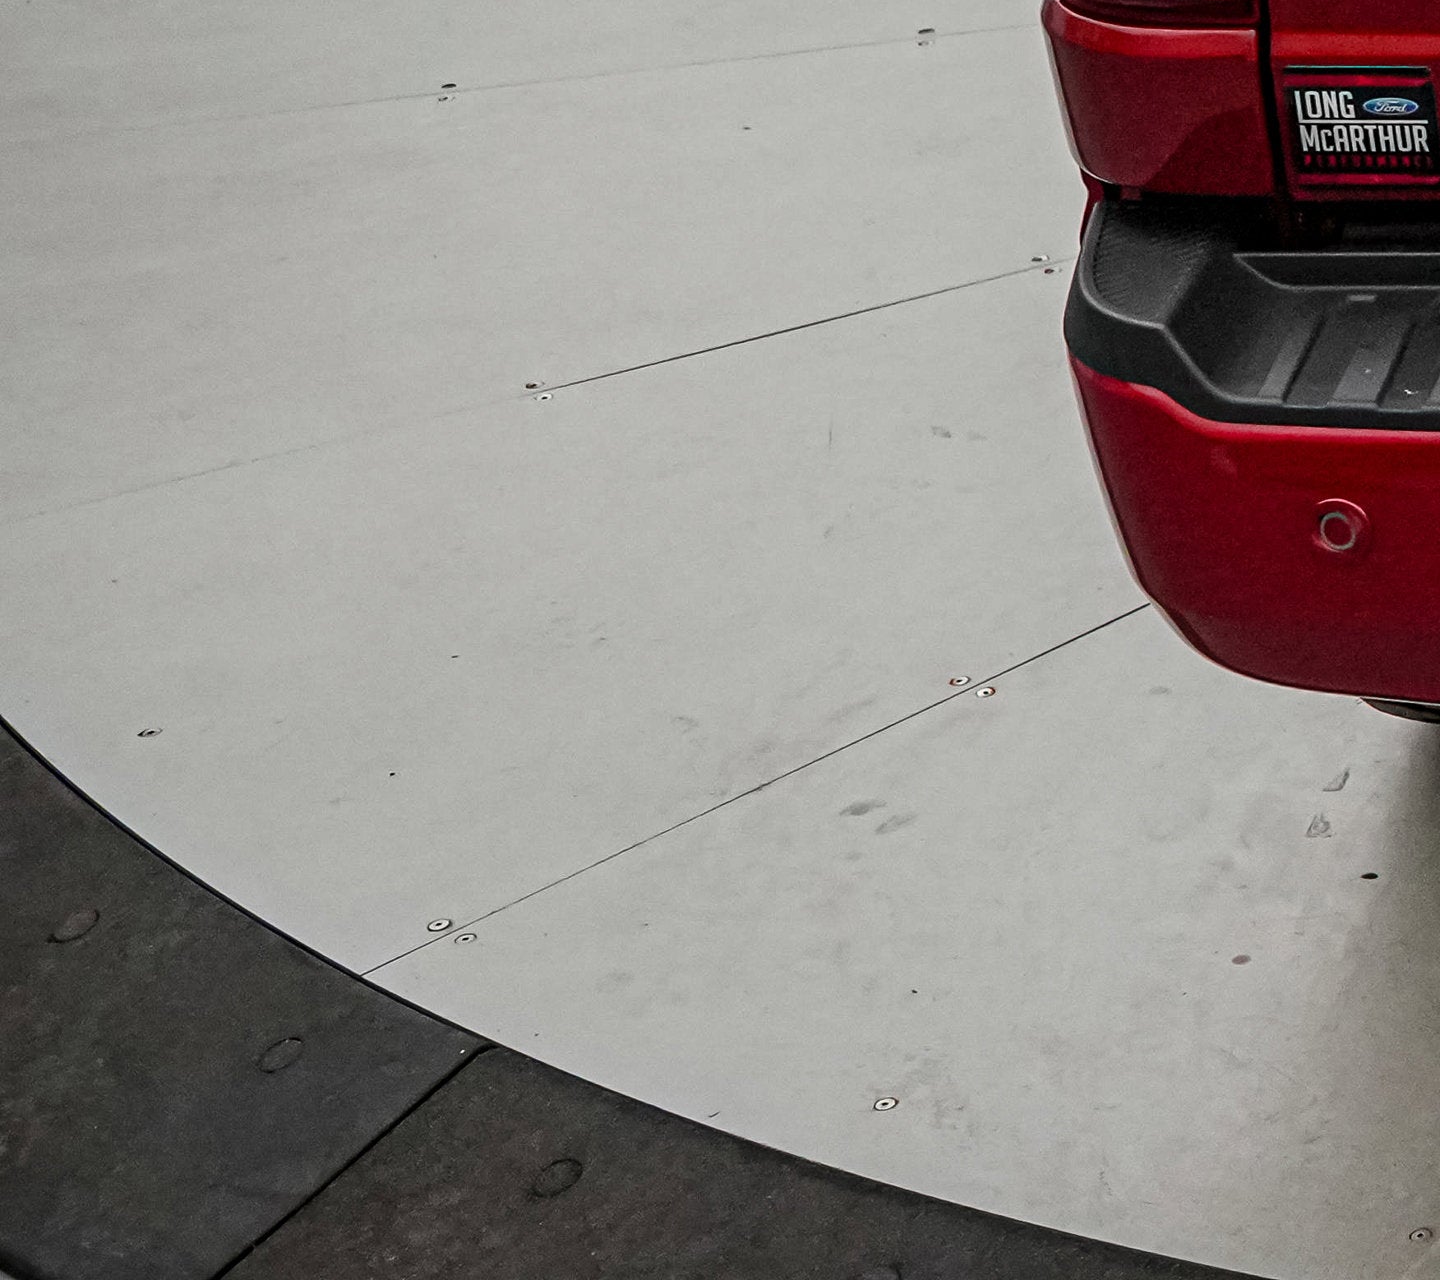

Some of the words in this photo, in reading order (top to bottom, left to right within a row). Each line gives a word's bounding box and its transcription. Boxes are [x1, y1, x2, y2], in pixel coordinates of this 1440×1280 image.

[1294, 90, 1357, 123] LONG
[1373, 98, 1409, 115] Ford
[1299, 124, 1431, 153] McARTHUR
